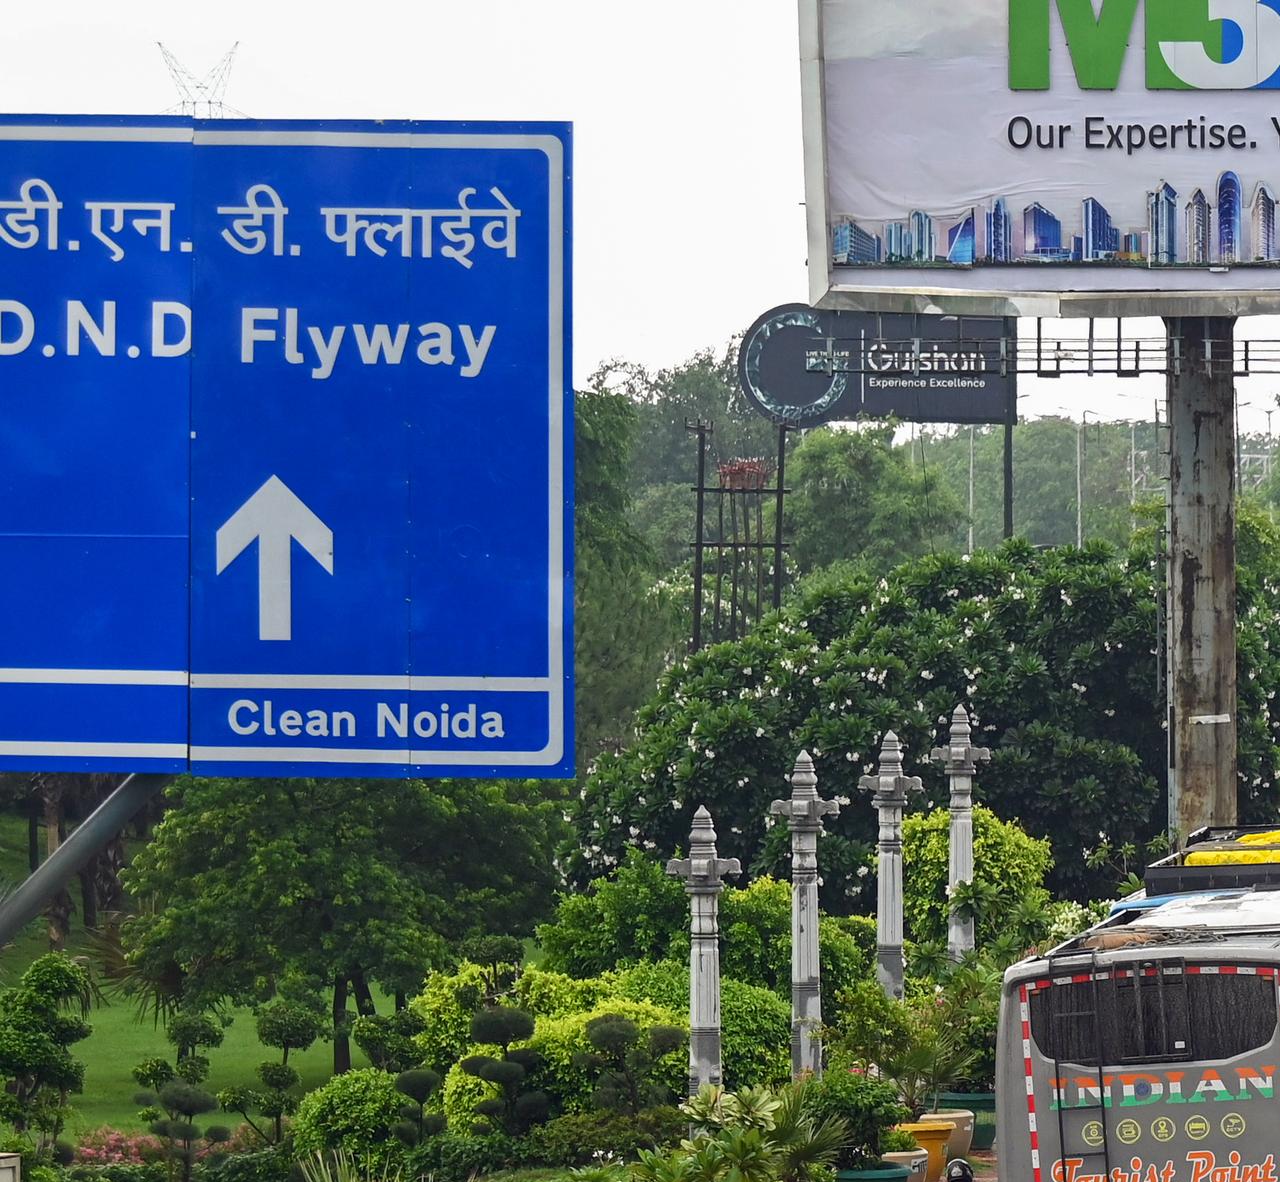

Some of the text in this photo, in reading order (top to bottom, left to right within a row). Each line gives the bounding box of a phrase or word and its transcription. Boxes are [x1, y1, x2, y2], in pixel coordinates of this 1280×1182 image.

[1007, 117, 1070, 149] Our
[1084, 116, 1257, 155] Expertise.
[217, 183, 302, 257] डी.
[321, 186, 521, 269] फ्लाईवे
[0, 300, 497, 380] D.N.D Flyway
[869, 377, 985, 389] Experience Excellence
[228, 699, 505, 739] Clean Noida
[1049, 1066, 1277, 1111] INDIAN
